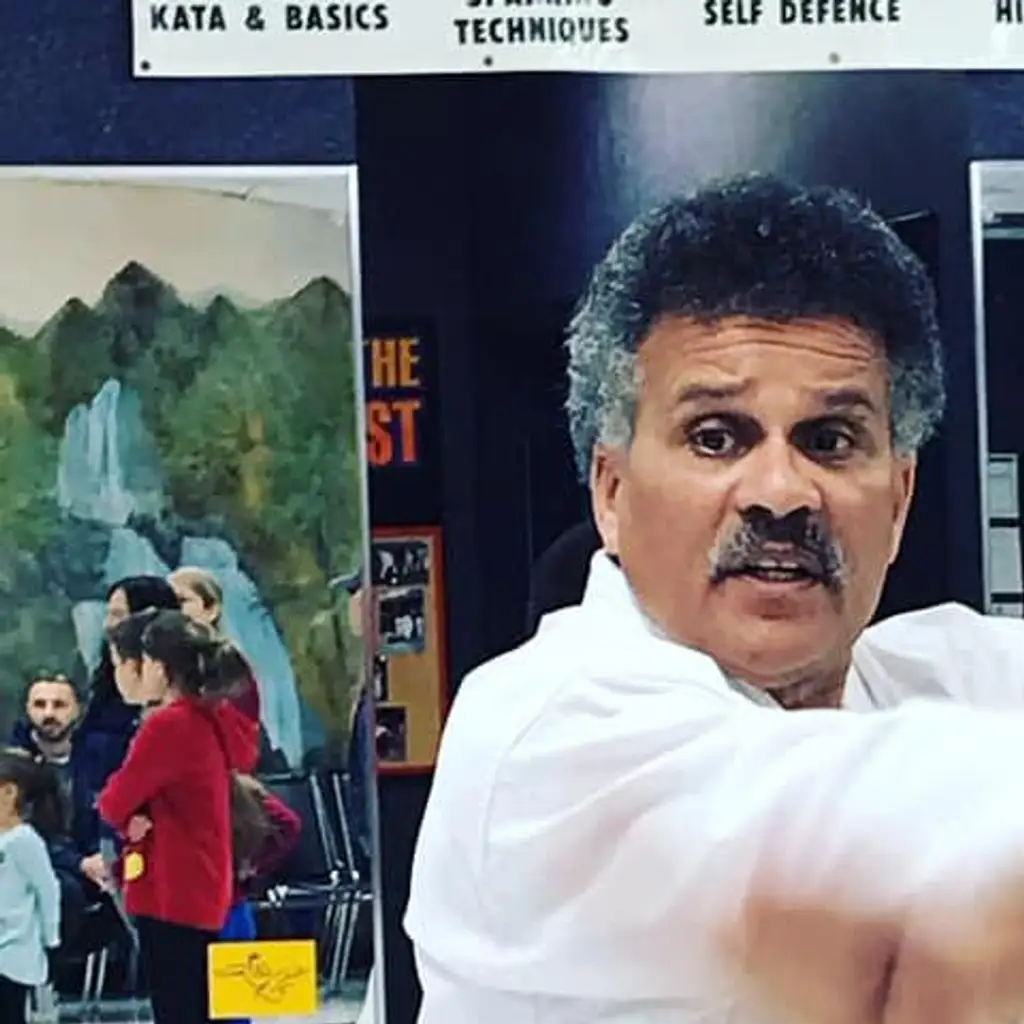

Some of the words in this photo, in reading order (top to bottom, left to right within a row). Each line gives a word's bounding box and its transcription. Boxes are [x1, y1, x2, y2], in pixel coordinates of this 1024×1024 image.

[150, 4, 227, 31] KATA
[245, 5, 265, 31] &
[286, 3, 389, 31] BASICS
[704, 0, 763, 25] SELF
[780, 0, 900, 24] DEFENCE
[453, 16, 629, 45] TECHNIQUES
[363, 338, 420, 388] HE
[367, 400, 420, 465] ST
